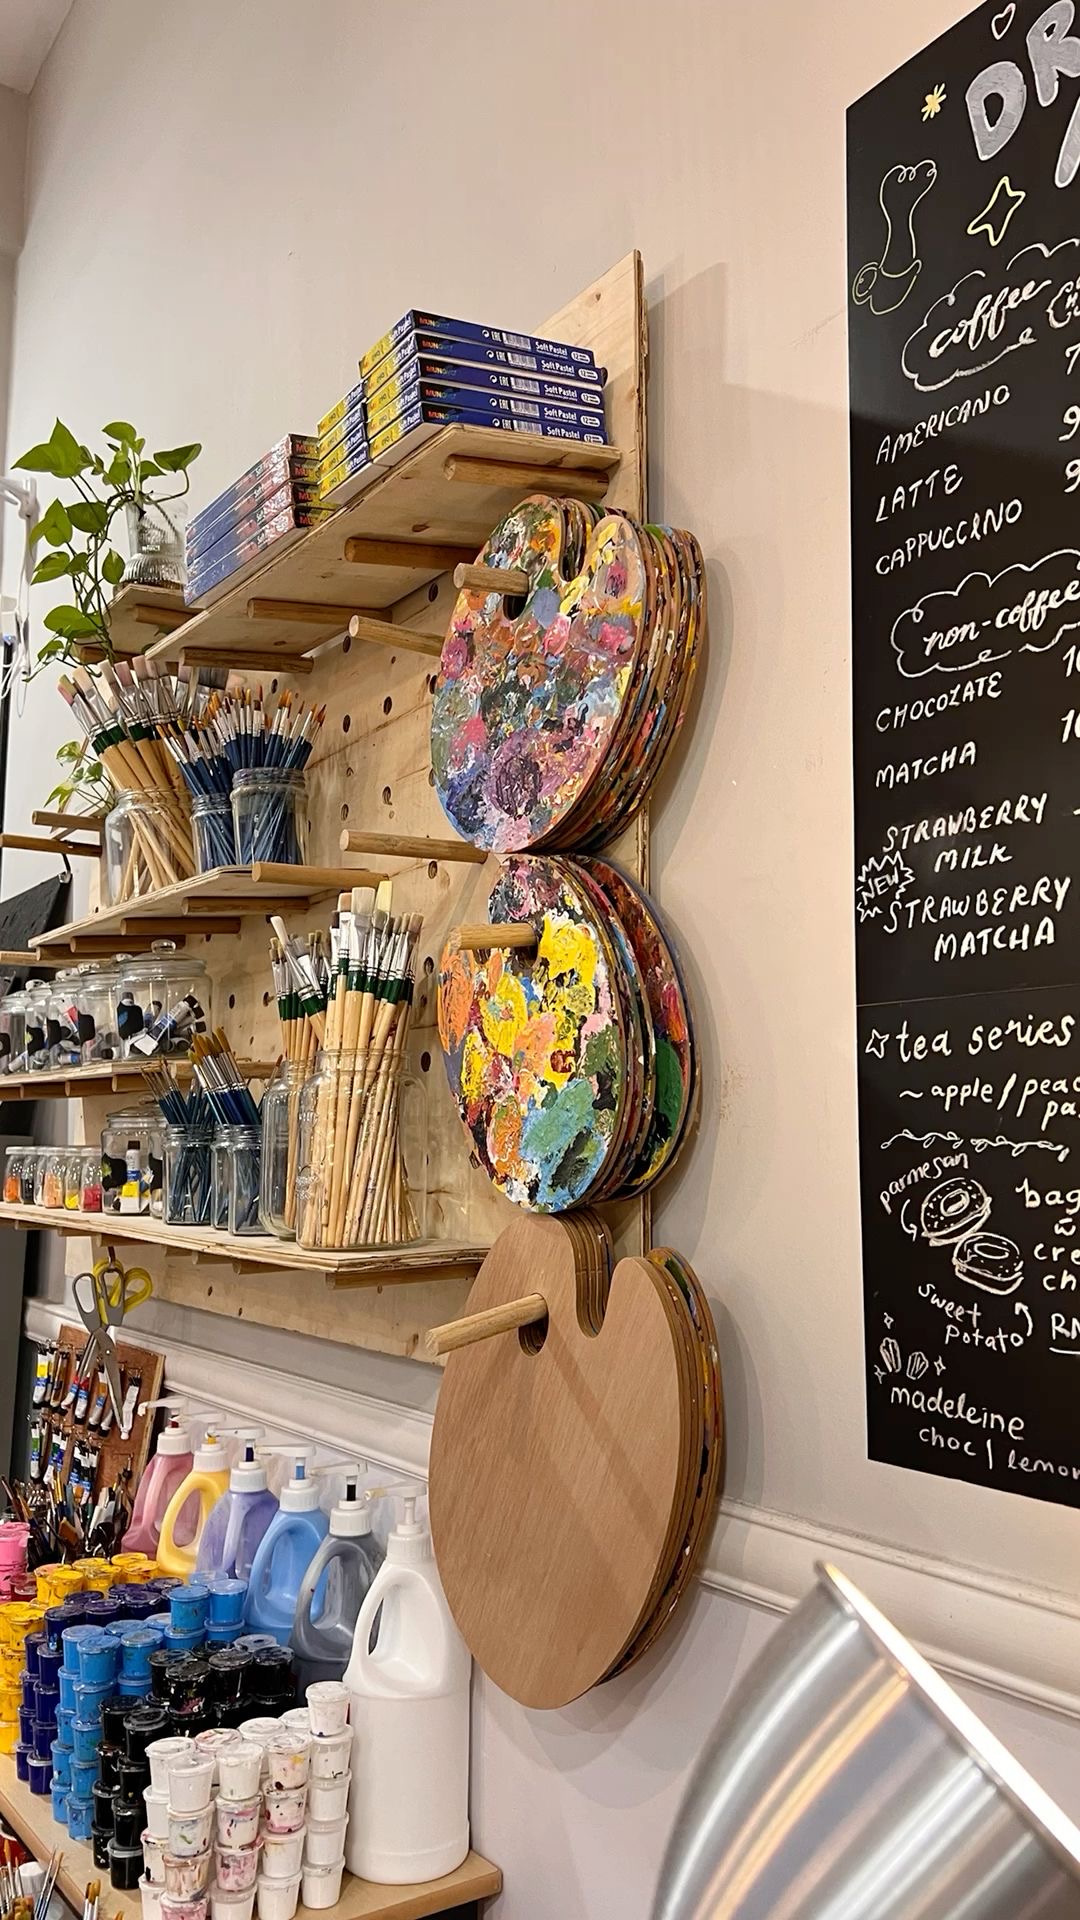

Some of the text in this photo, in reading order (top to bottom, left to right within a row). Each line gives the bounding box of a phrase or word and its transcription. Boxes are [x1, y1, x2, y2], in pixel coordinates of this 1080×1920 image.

[929, 280, 1051, 358] coffee
[536, 342, 549, 351] Soft
[549, 345, 567, 356] Pastel
[541, 360, 556, 369] Soft
[556, 362, 575, 373] Pastel
[544, 385, 558, 393] Soft
[559, 387, 577, 397] Pastel
[544, 407, 558, 416] Soft
[559, 410, 577, 420] Pastel
[547, 427, 580, 439] Soft Pastel
[876, 385, 1010, 464] AMERICANO
[1059, 405, 1080, 441] 9
[876, 465, 963, 522] LATTE
[876, 499, 1022, 574] CAPPUCCINO
[923, 580, 1080, 656] non-coffee
[876, 672, 1002, 732] CHOCOLATE
[876, 742, 976, 788] MATCHA
[883, 793, 1047, 852] STRAWBERRY
[934, 844, 1012, 872] MILK
[861, 866, 898, 905] NEW
[883, 877, 1070, 933] STRAWBERRY
[935, 917, 1054, 961] MATCHA
[896, 1015, 1075, 1062] tea series
[1041, 1101, 1080, 1131] pa
[880, 1153, 968, 1214] parmesan
[1043, 1270, 1077, 1291] ch
[919, 1284, 981, 1327] sweet
[891, 1387, 1024, 1440] madeleine
[920, 1427, 976, 1456] choc
